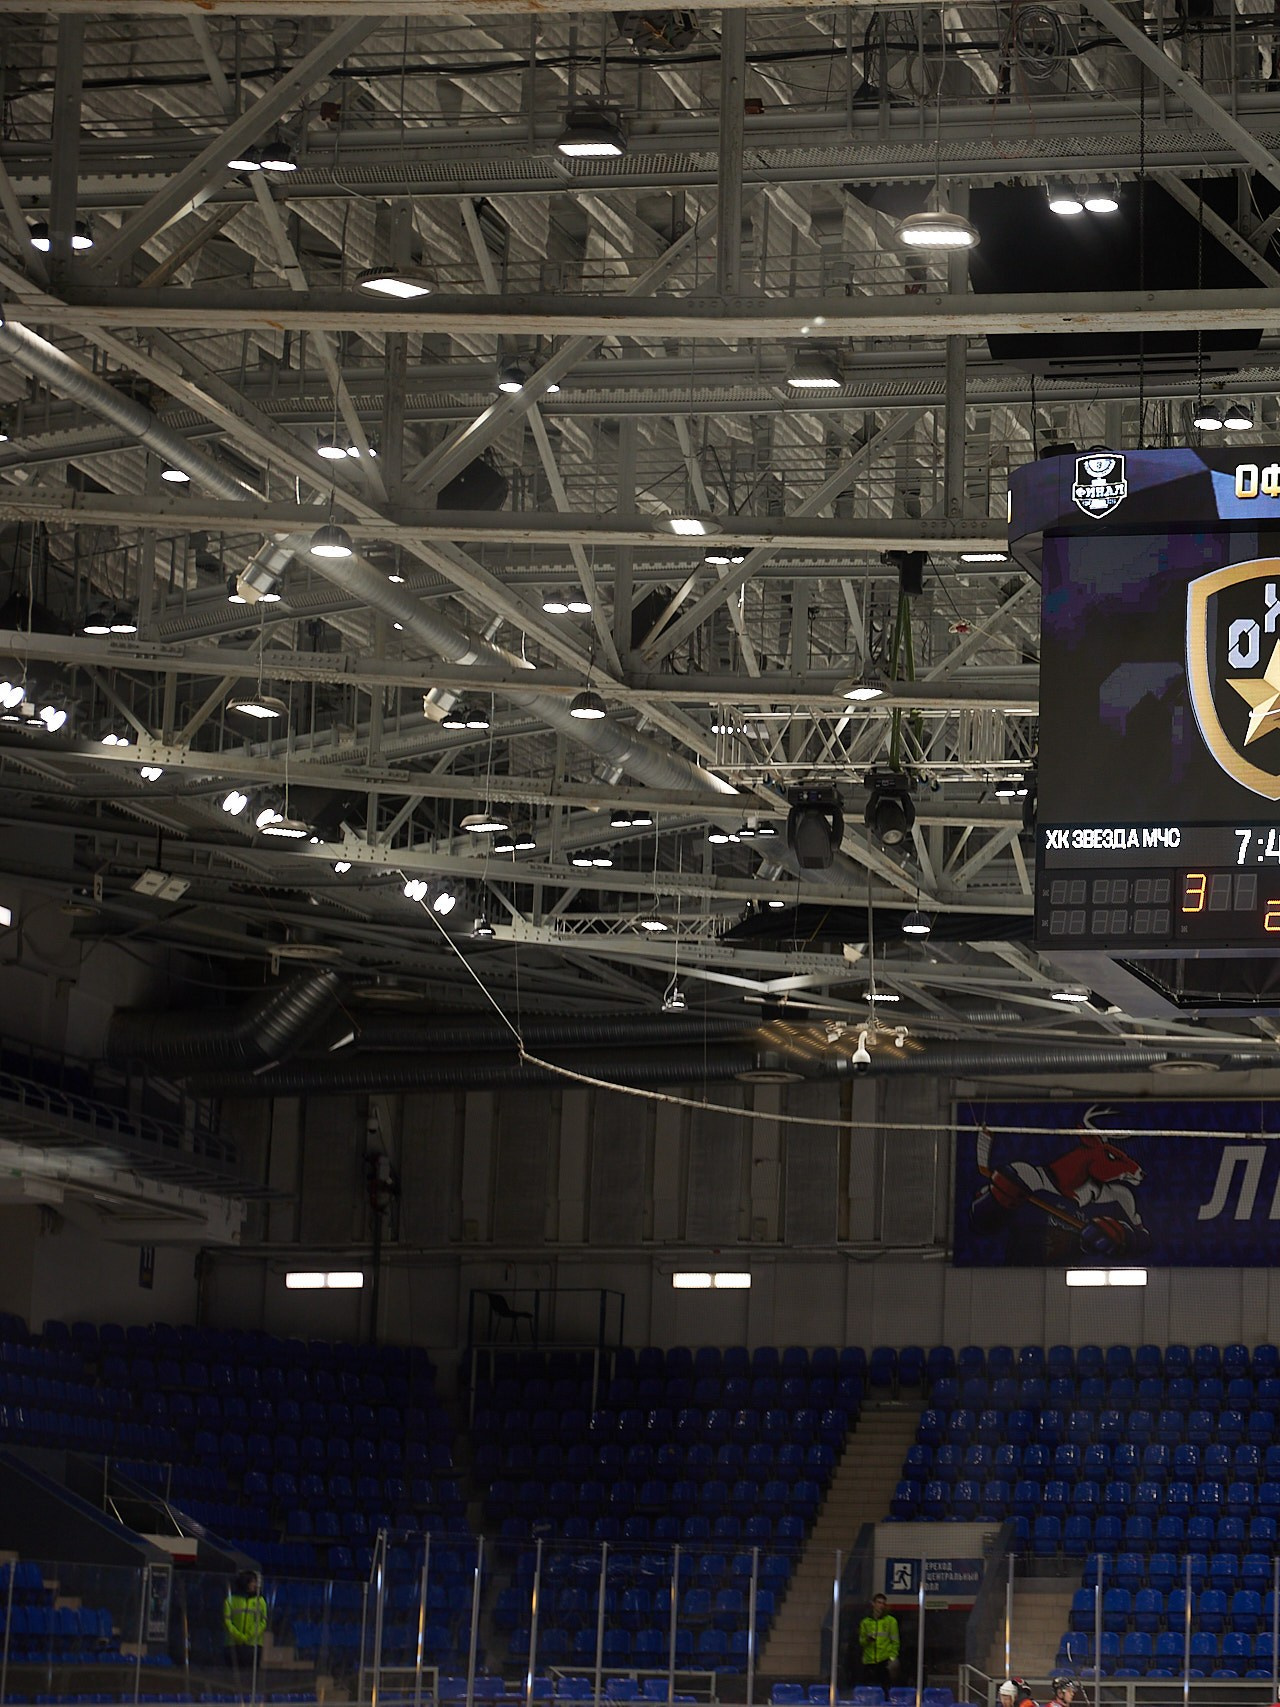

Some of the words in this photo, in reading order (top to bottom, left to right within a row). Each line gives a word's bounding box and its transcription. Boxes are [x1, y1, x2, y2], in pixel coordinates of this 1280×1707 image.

[1045, 829, 1069, 849] ХК
[1072, 828, 1140, 849] ЗВЕЗДА
[1142, 828, 1181, 848] МЧС
[1181, 872, 1207, 912] 3
[925, 1562, 952, 1571] ЕРЕХОД
